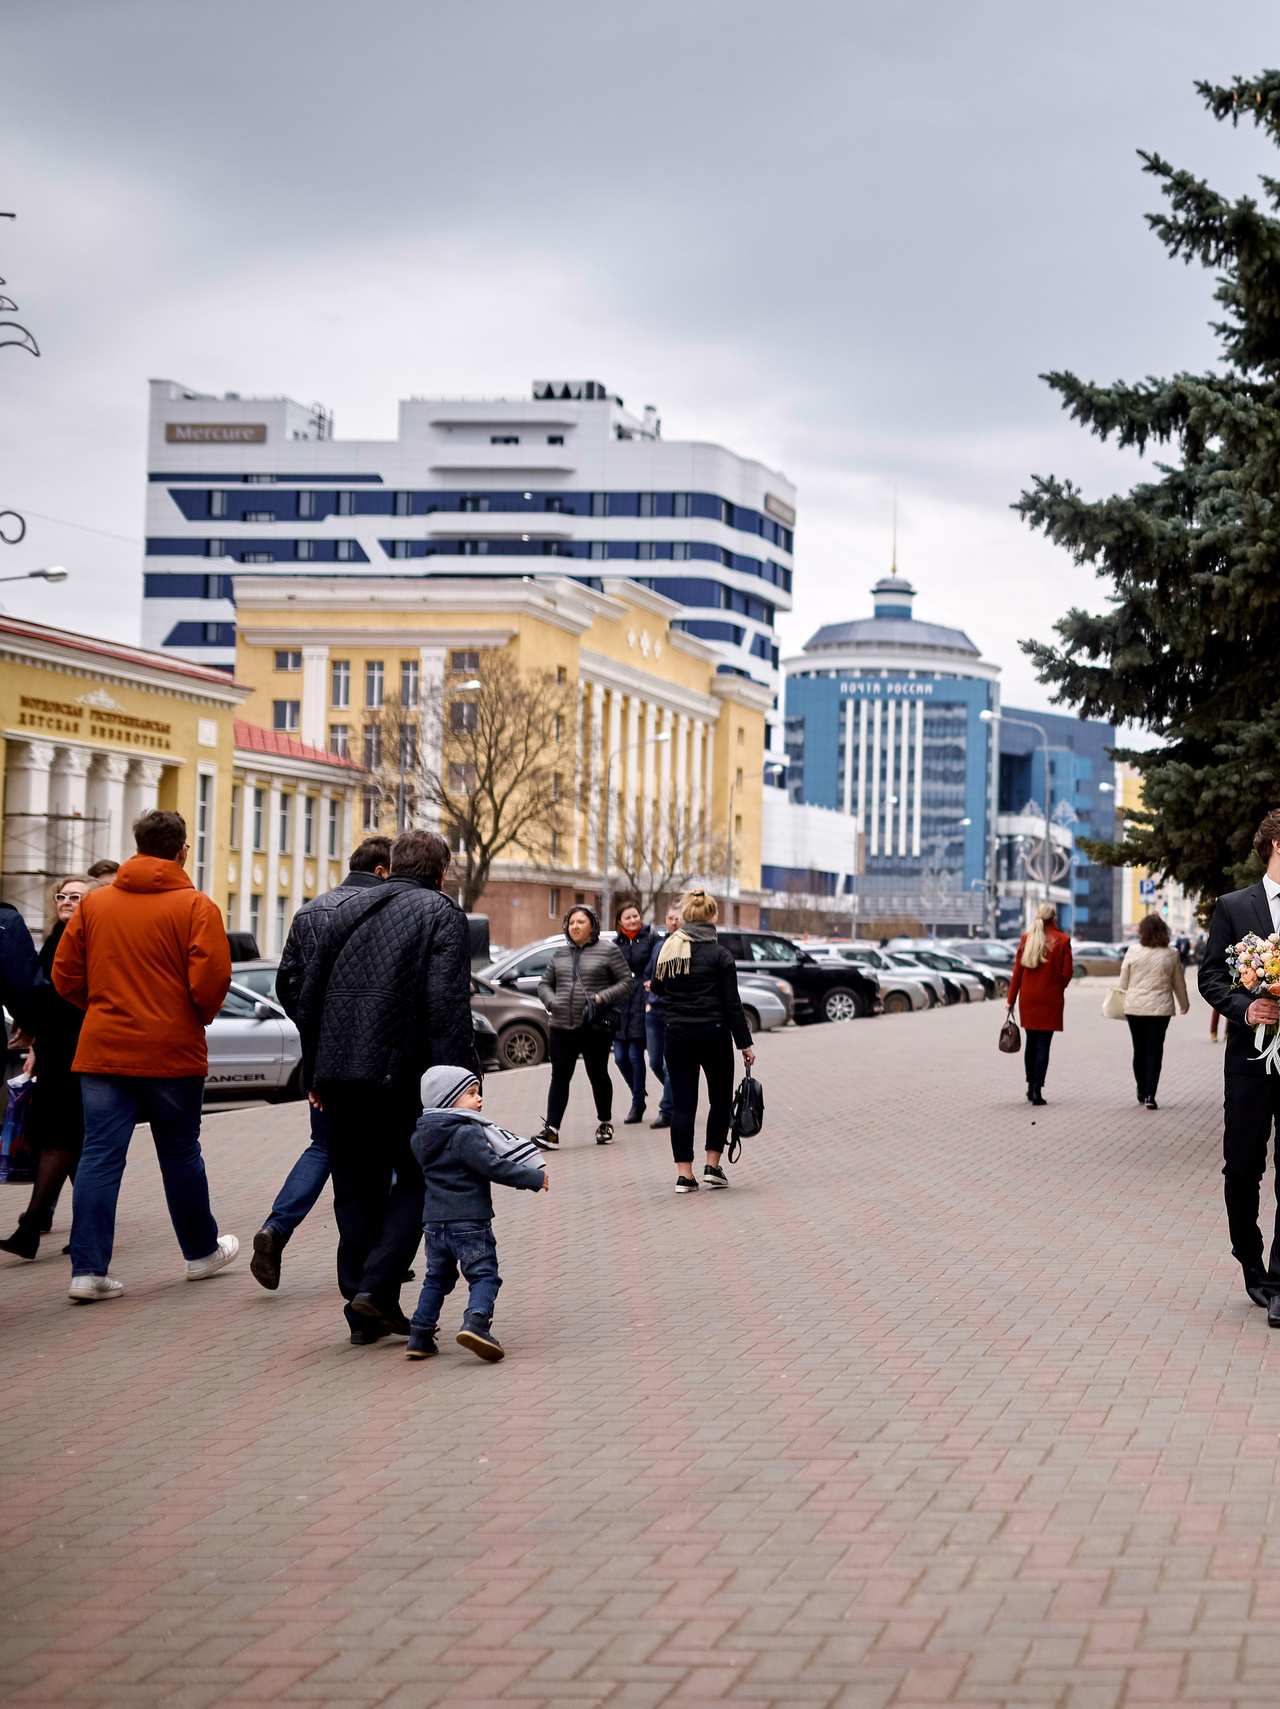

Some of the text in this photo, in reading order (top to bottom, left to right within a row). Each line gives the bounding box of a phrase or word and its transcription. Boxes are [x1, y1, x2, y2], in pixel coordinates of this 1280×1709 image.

[175, 426, 254, 440] Mercure
[841, 682, 933, 695] ПОЧТА РОССИИ
[206, 1074, 266, 1082] ANCER
